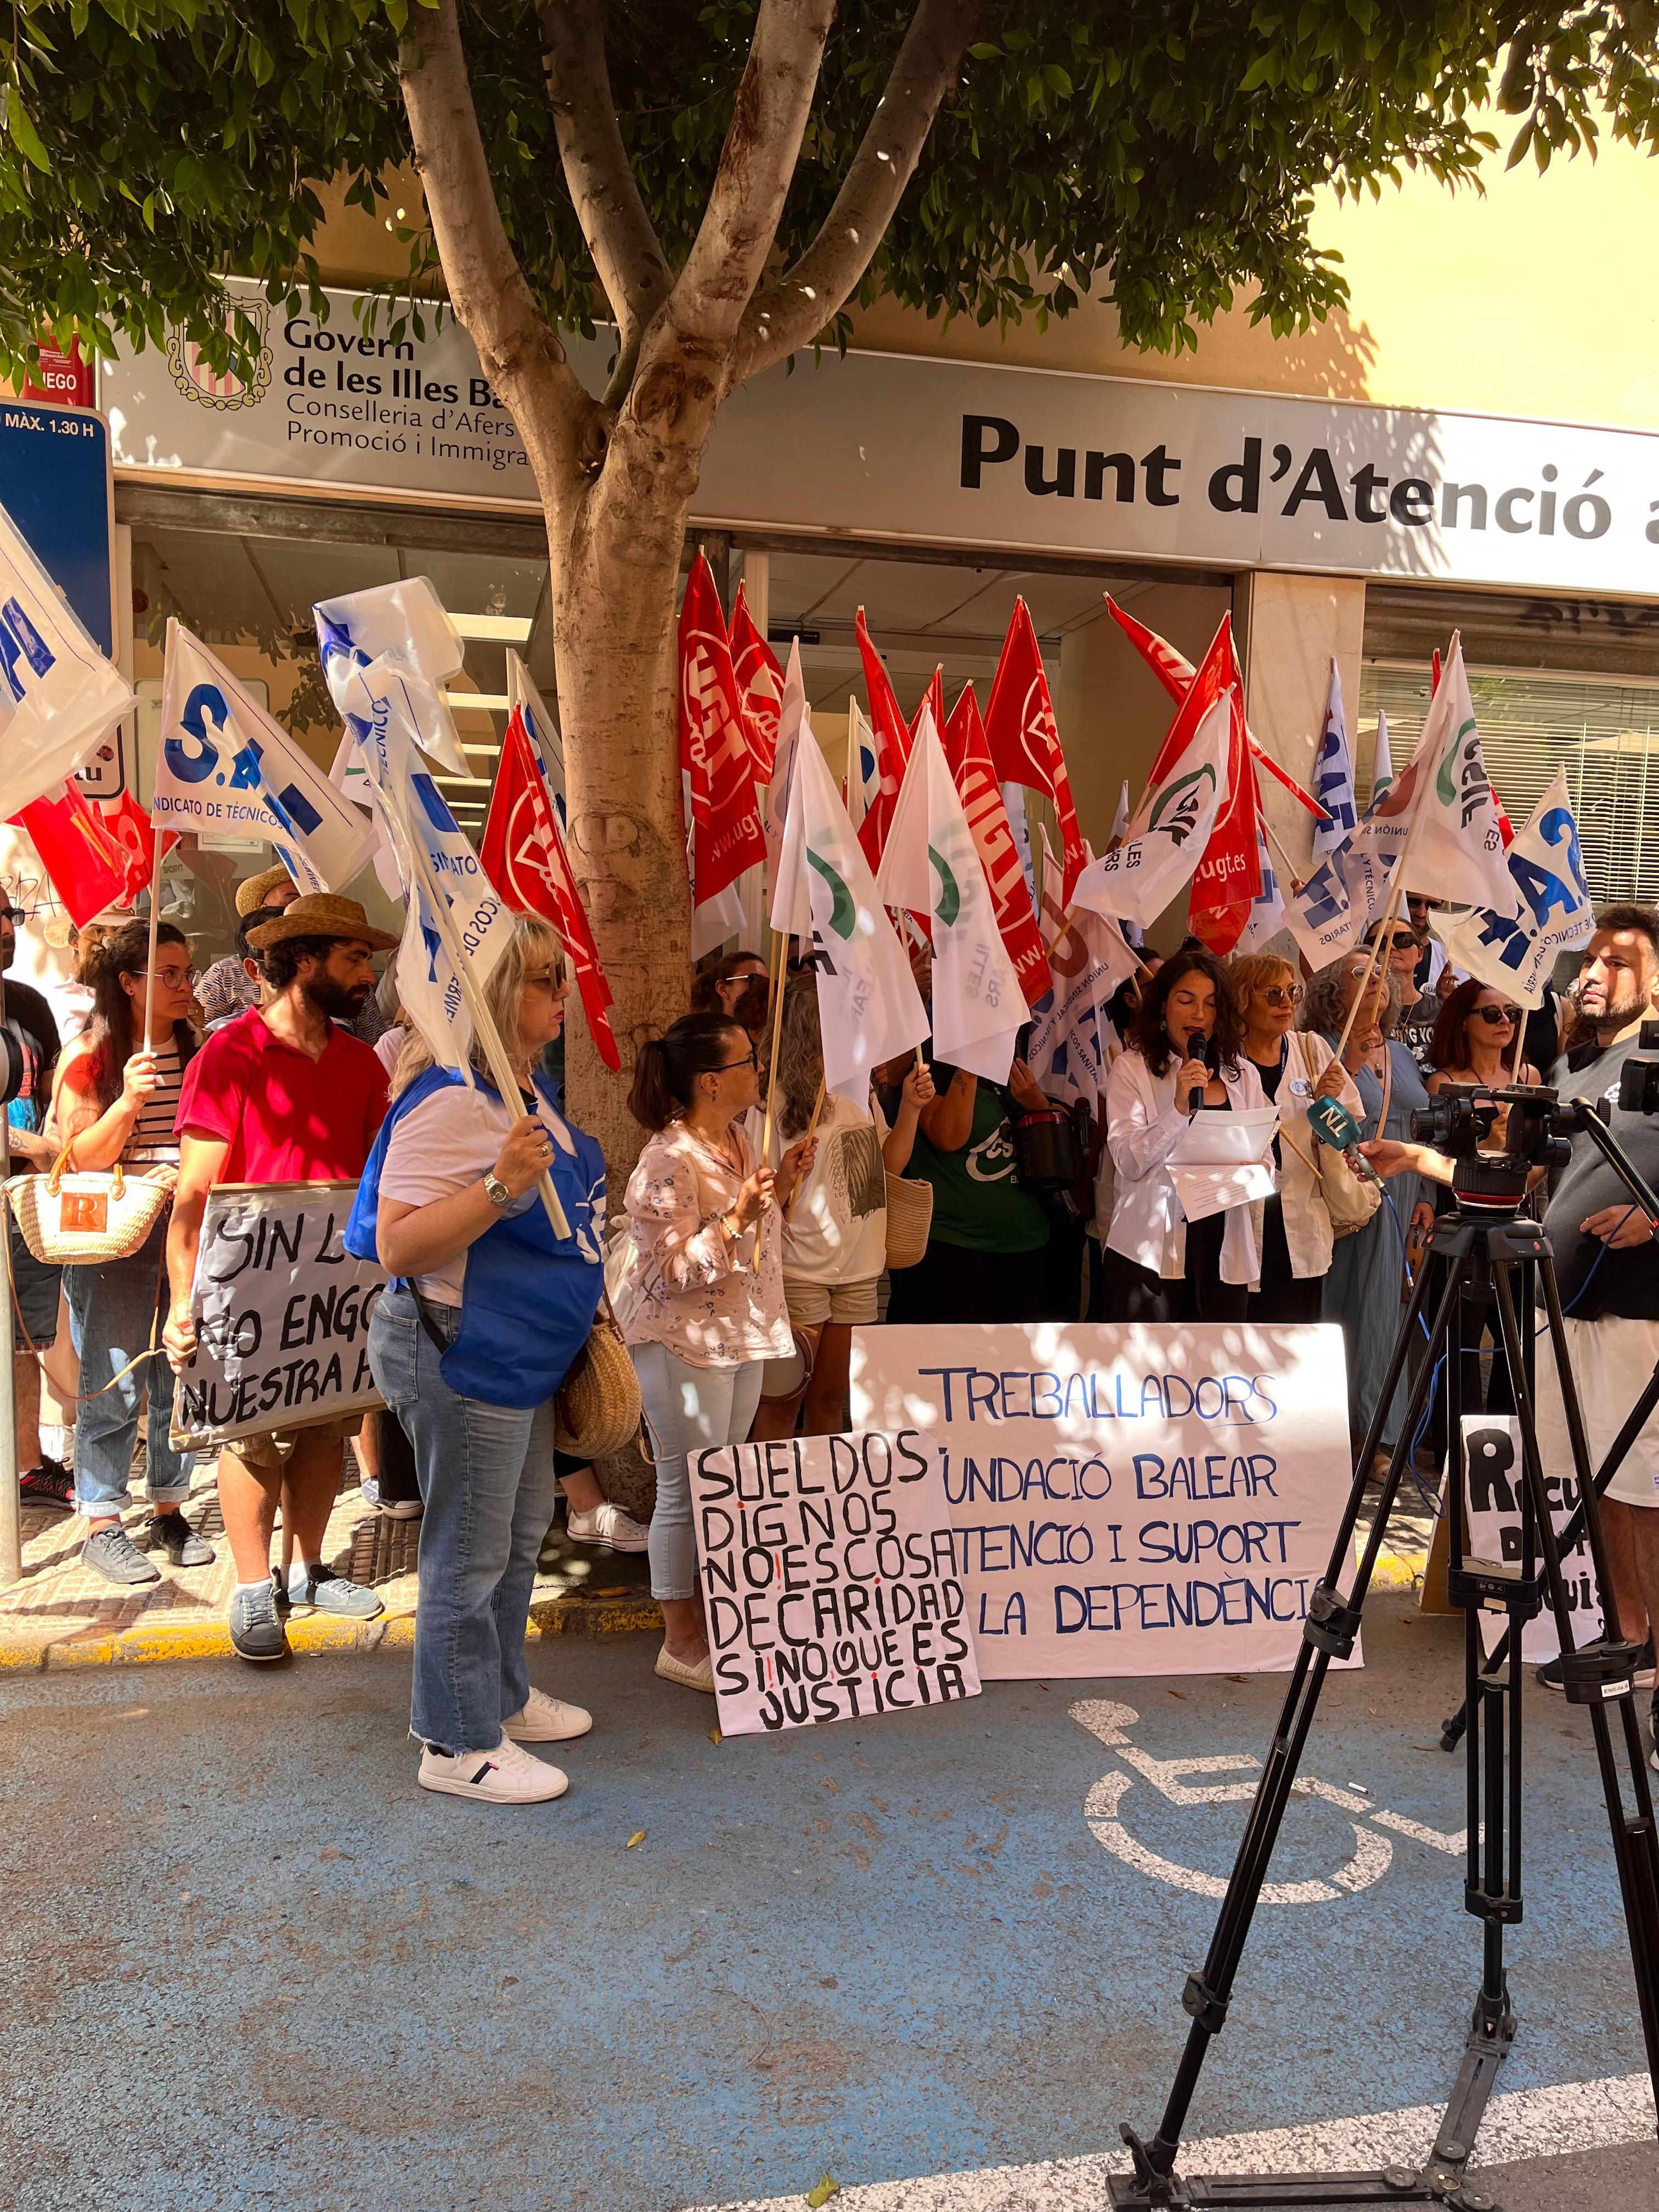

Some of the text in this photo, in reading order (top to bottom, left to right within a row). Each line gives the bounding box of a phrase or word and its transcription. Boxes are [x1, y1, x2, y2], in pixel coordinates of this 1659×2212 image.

[284, 319, 414, 361] Govern
[29, 372, 77, 391] EGO
[284, 356, 507, 409] de les Illes Ba
[5, 411, 94, 437] MÀX. 1.30 H
[287, 393, 422, 427] Conselleria
[287, 421, 406, 453] Promoció
[416, 434, 420, 455] i
[960, 414, 1182, 506] Punt
[153, 797, 202, 815] NDICATO
[206, 802, 222, 817] DE
[1195, 851, 1246, 883] .ugt.es
[68, 1197, 99, 1227] R
[208, 1213, 305, 1283] SIN
[188, 1304, 262, 1369] NO
[182, 1351, 342, 1427] NUESTRA
[918, 1367, 1277, 1427] TREBALLADORS
[697, 1430, 928, 1502] SUELDOS
[939, 1448, 1279, 1504] UNDACIÓ BALEAR
[952, 1521, 1302, 1575] TENCIÓ I SUPORT
[979, 1572, 1327, 1636] LA DEPENDÈNCI
[912, 1620, 968, 1667] ES
[759, 1663, 966, 1730] JUSTICIA
